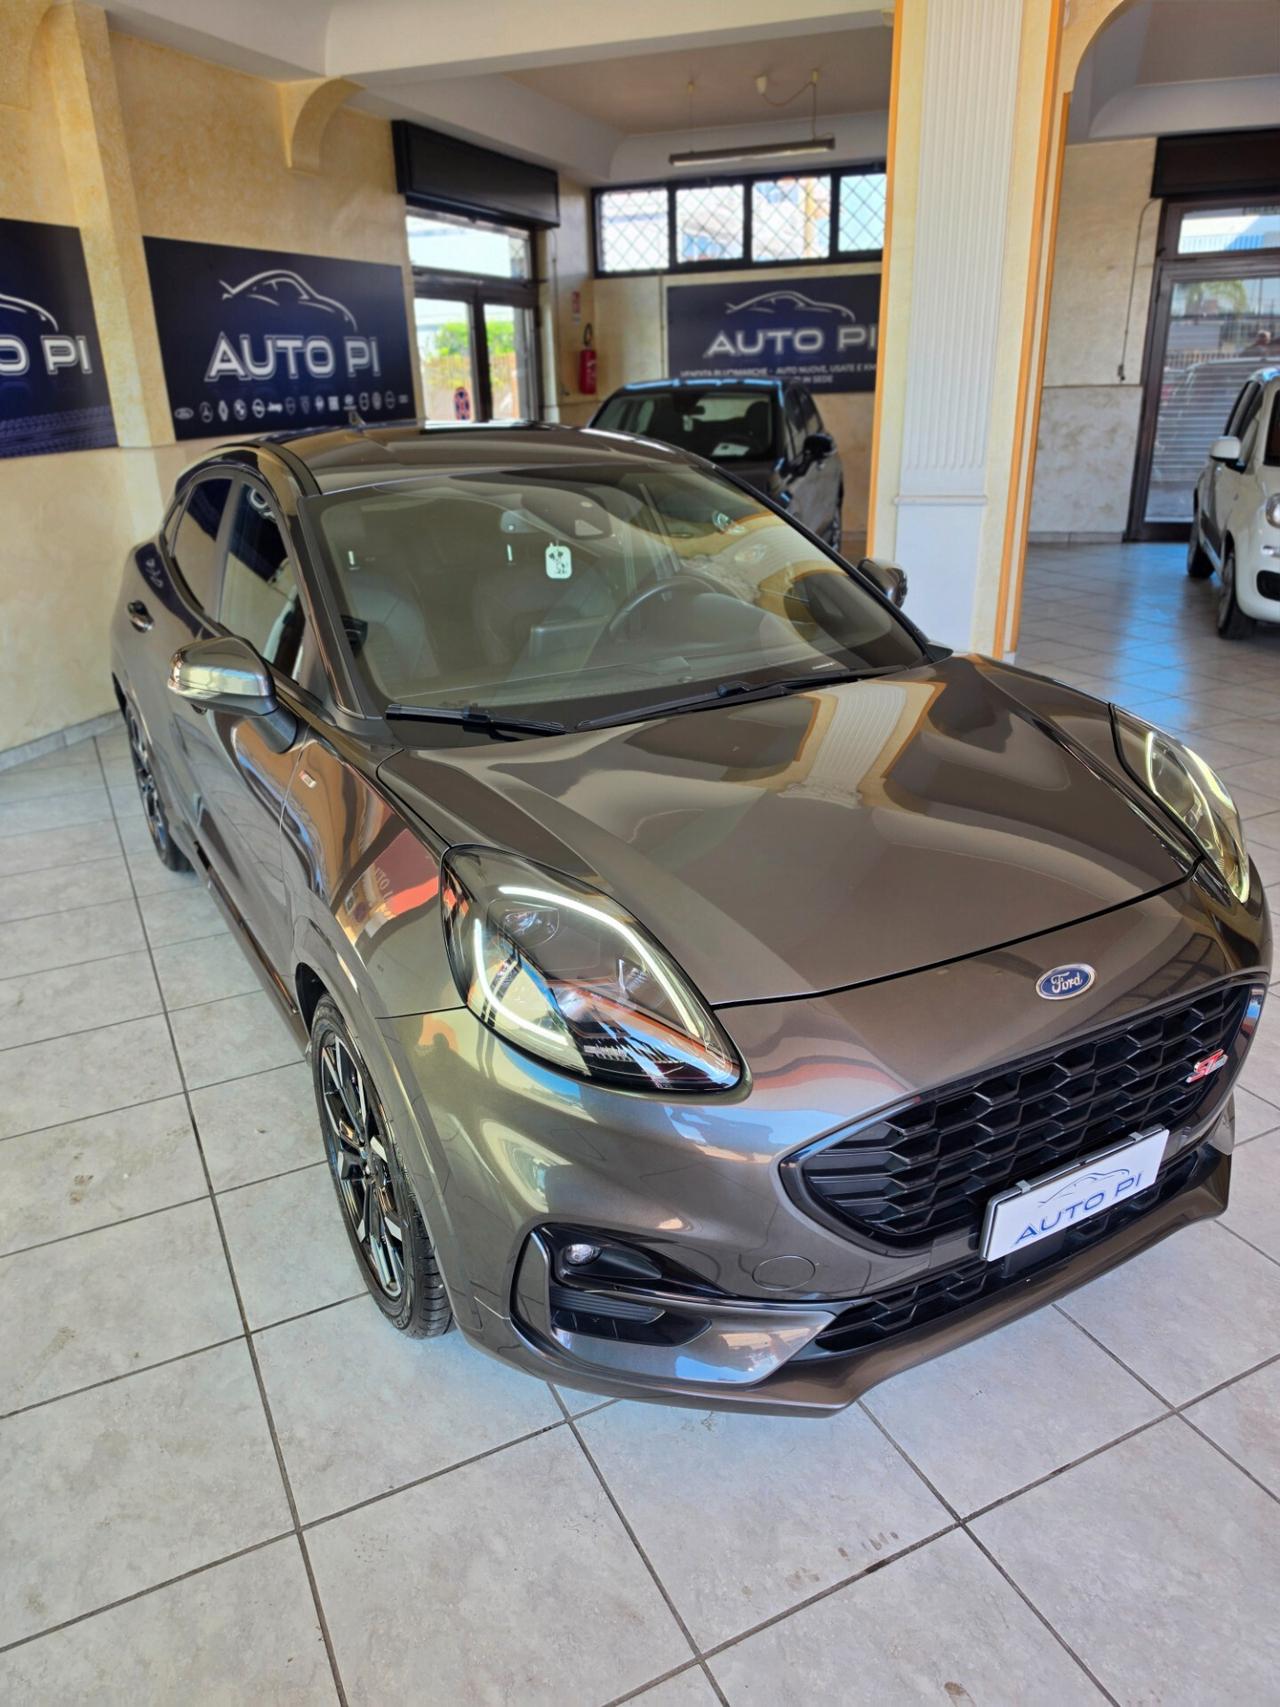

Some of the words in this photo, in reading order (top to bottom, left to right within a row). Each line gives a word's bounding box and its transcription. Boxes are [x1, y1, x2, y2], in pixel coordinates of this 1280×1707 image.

[40, 335, 93, 375] PI
[203, 330, 337, 382] AUTO
[343, 336, 382, 378] PI
[704, 329, 824, 358] AUTO
[837, 323, 877, 352] PI
[776, 366, 798, 376] AUTO
[1051, 971, 1083, 994] Ford
[1014, 1192, 1105, 1245] AUTO
[1115, 1173, 1142, 1198] PI
